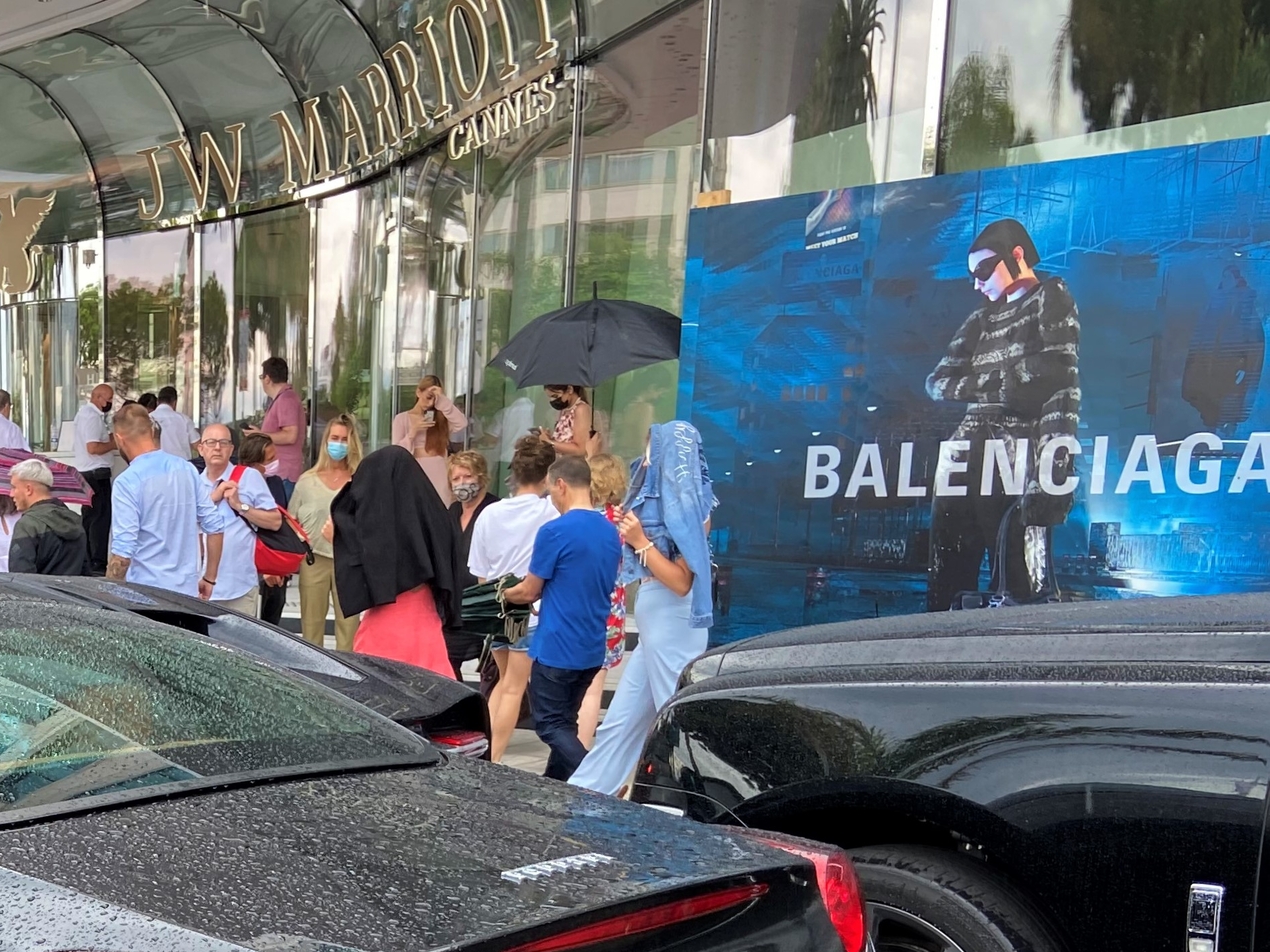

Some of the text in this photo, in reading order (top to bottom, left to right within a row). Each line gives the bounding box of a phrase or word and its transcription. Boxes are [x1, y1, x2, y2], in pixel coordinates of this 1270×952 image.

[136, 0, 559, 221] JW MARRIOTT
[447, 73, 558, 161] CANNES
[803, 432, 1270, 499] BALENCIAGA
